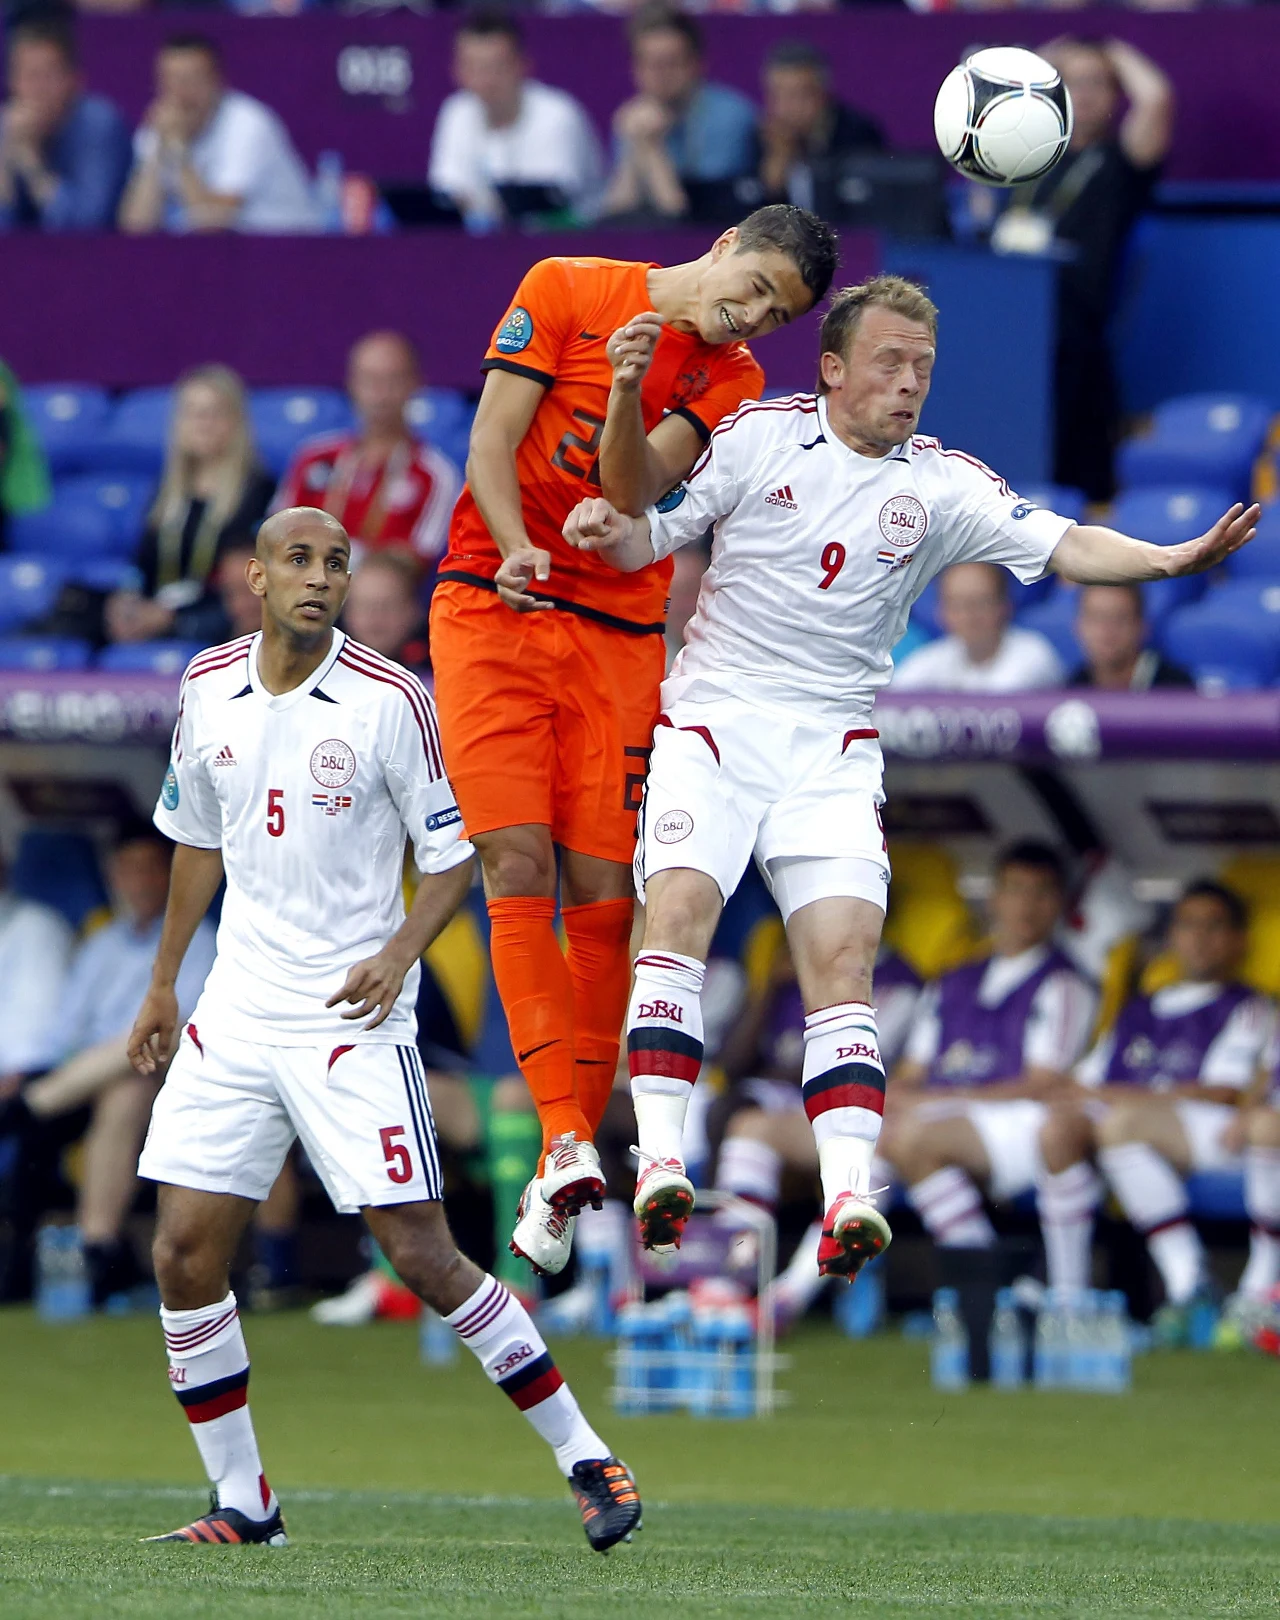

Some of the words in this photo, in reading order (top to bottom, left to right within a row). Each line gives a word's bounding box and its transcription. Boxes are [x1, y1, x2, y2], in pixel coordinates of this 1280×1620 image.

[551, 408, 606, 487] 2
[765, 497, 798, 510] adidas
[890, 511, 916, 529] DBU
[817, 541, 846, 590] 9
[320, 755, 345, 770] DBU
[266, 789, 285, 838] 5
[663, 821, 684, 832] DBU
[637, 1000, 683, 1024] DBU
[836, 1043, 881, 1065] DBU
[378, 1125, 413, 1184] 5
[494, 1343, 534, 1375] DBU
